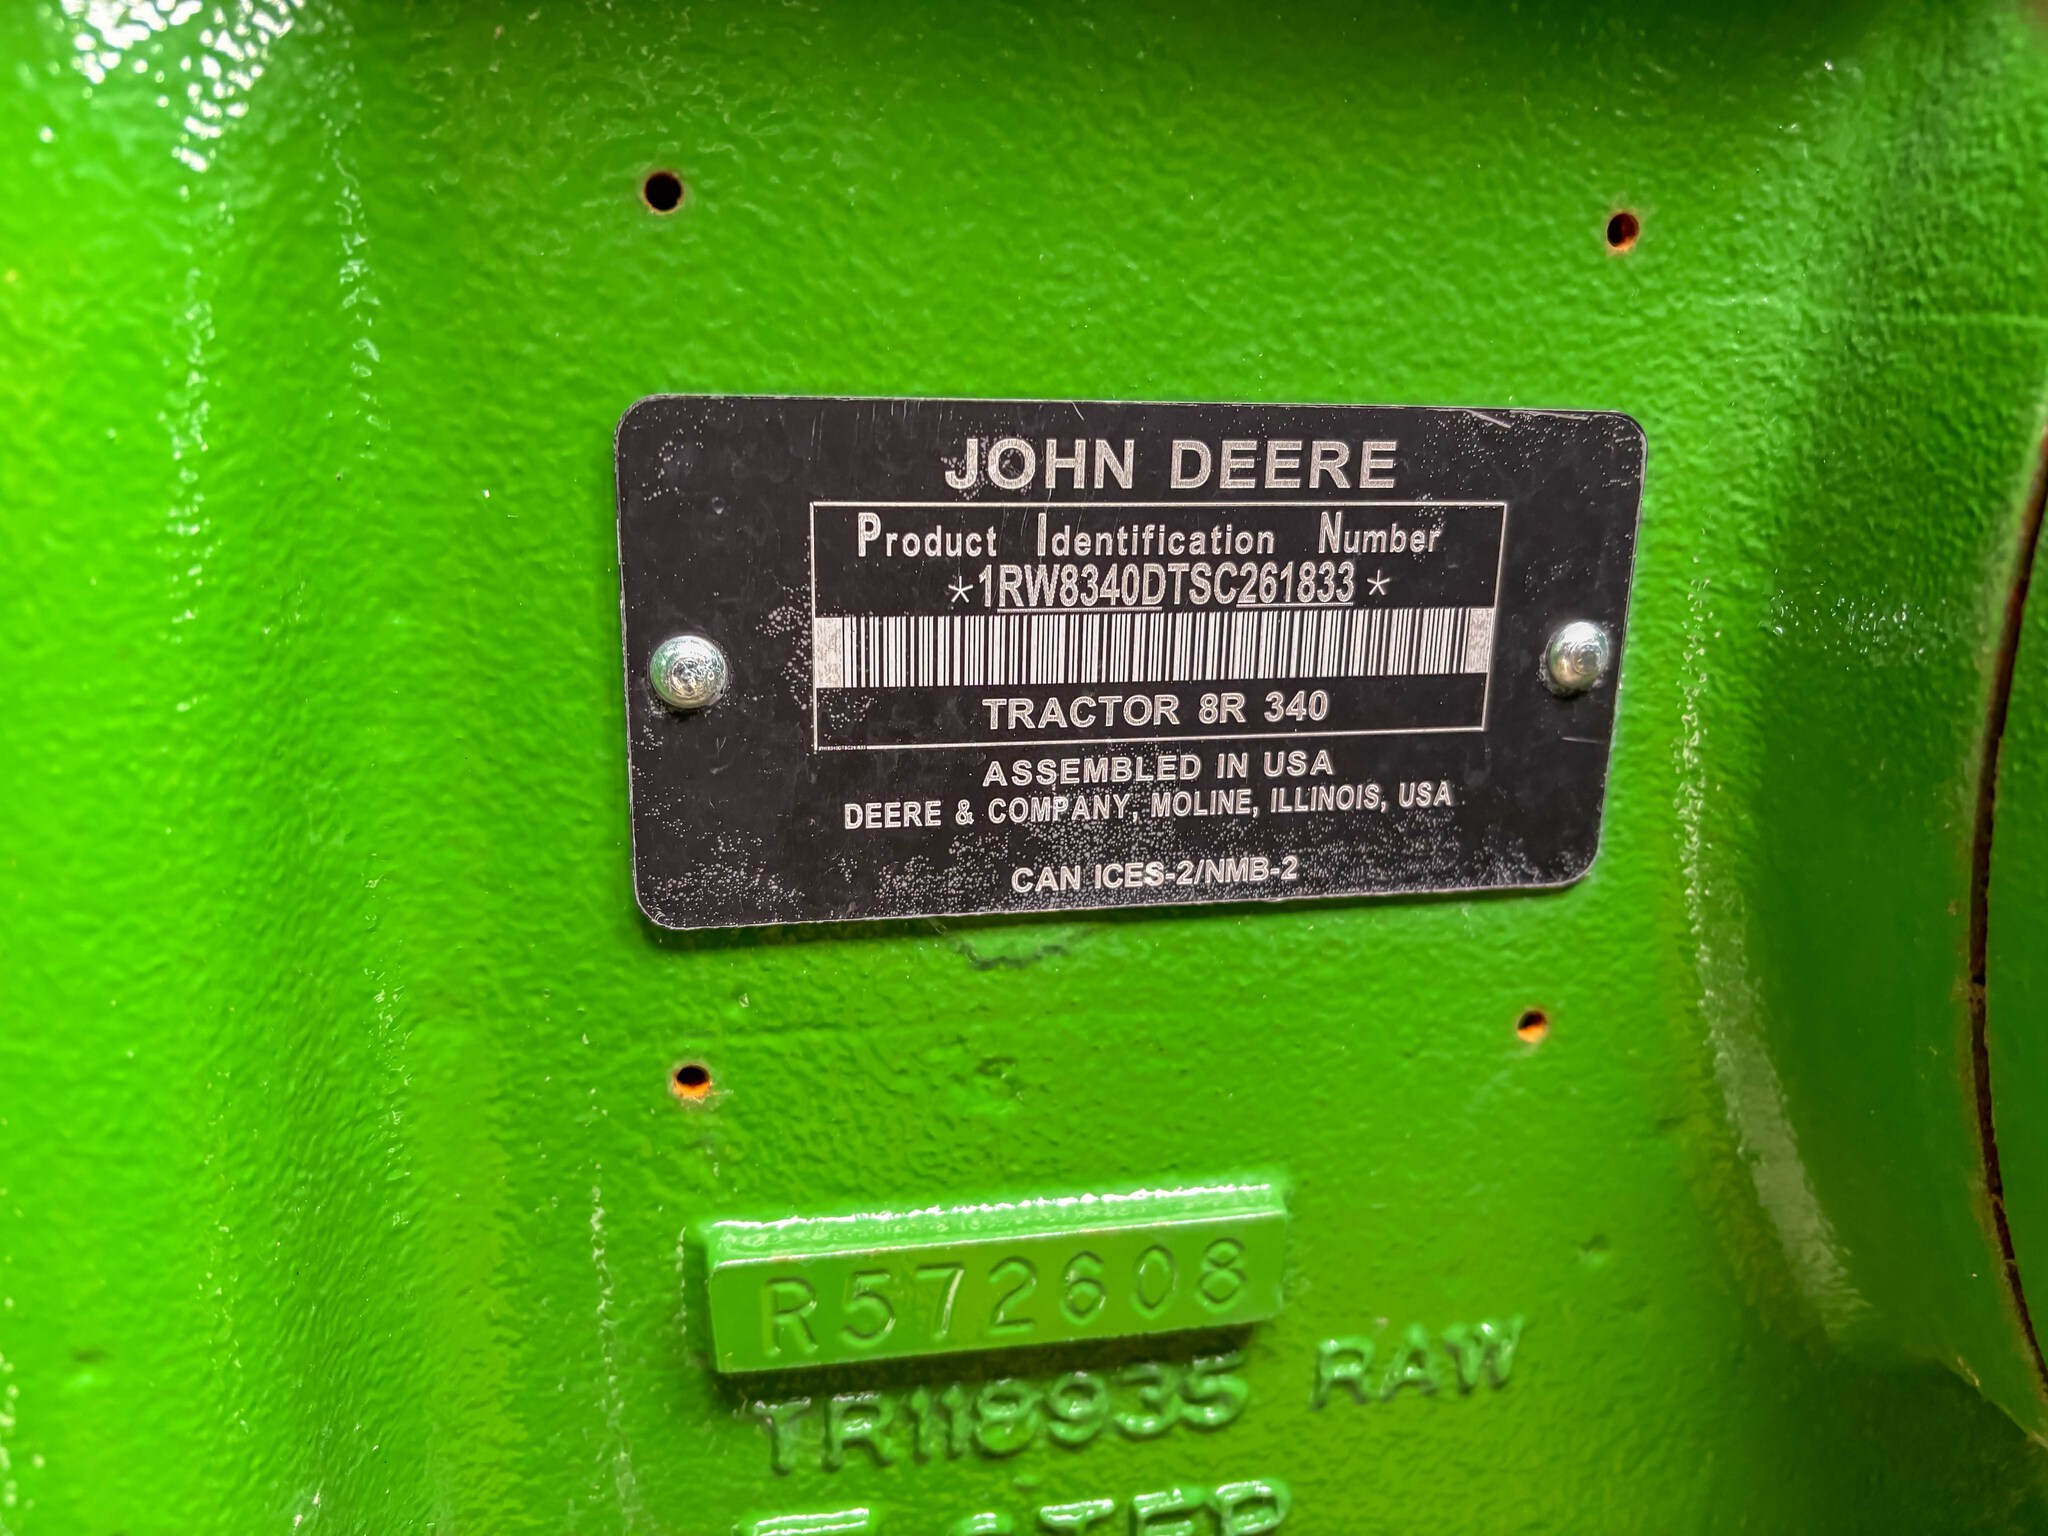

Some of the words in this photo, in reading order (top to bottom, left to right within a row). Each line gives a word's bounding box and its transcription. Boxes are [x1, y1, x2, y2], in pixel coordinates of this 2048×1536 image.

[944, 439, 1134, 490] JOHN
[1170, 441, 1398, 490] DEERE
[857, 513, 997, 557] Product
[1038, 513, 1275, 557] Identification
[1318, 511, 1441, 555] Number
[979, 561, 1355, 608] 1RW8340DTSC261833
[982, 694, 1181, 730] TRACTOR
[1198, 693, 1247, 725] 8R
[1263, 690, 1329, 722] 340
[982, 754, 1200, 787] ASSEMBLED
[1217, 753, 1247, 778] IN
[1263, 751, 1335, 777] USA
[843, 802, 942, 831] DEERE
[954, 801, 974, 824] &
[987, 793, 1139, 825] COMPANY,
[1150, 787, 1261, 818] MOLINE,
[1269, 783, 1389, 814] ILLINOIS,
[1397, 780, 1454, 808] USA
[1010, 867, 1081, 894] CAN
[1093, 855, 1302, 888] ICES-2/NMB-2
[762, 1237, 1248, 1357] R572608
[752, 1350, 1249, 1475] TR118935
[1311, 1317, 1524, 1409] RAW
